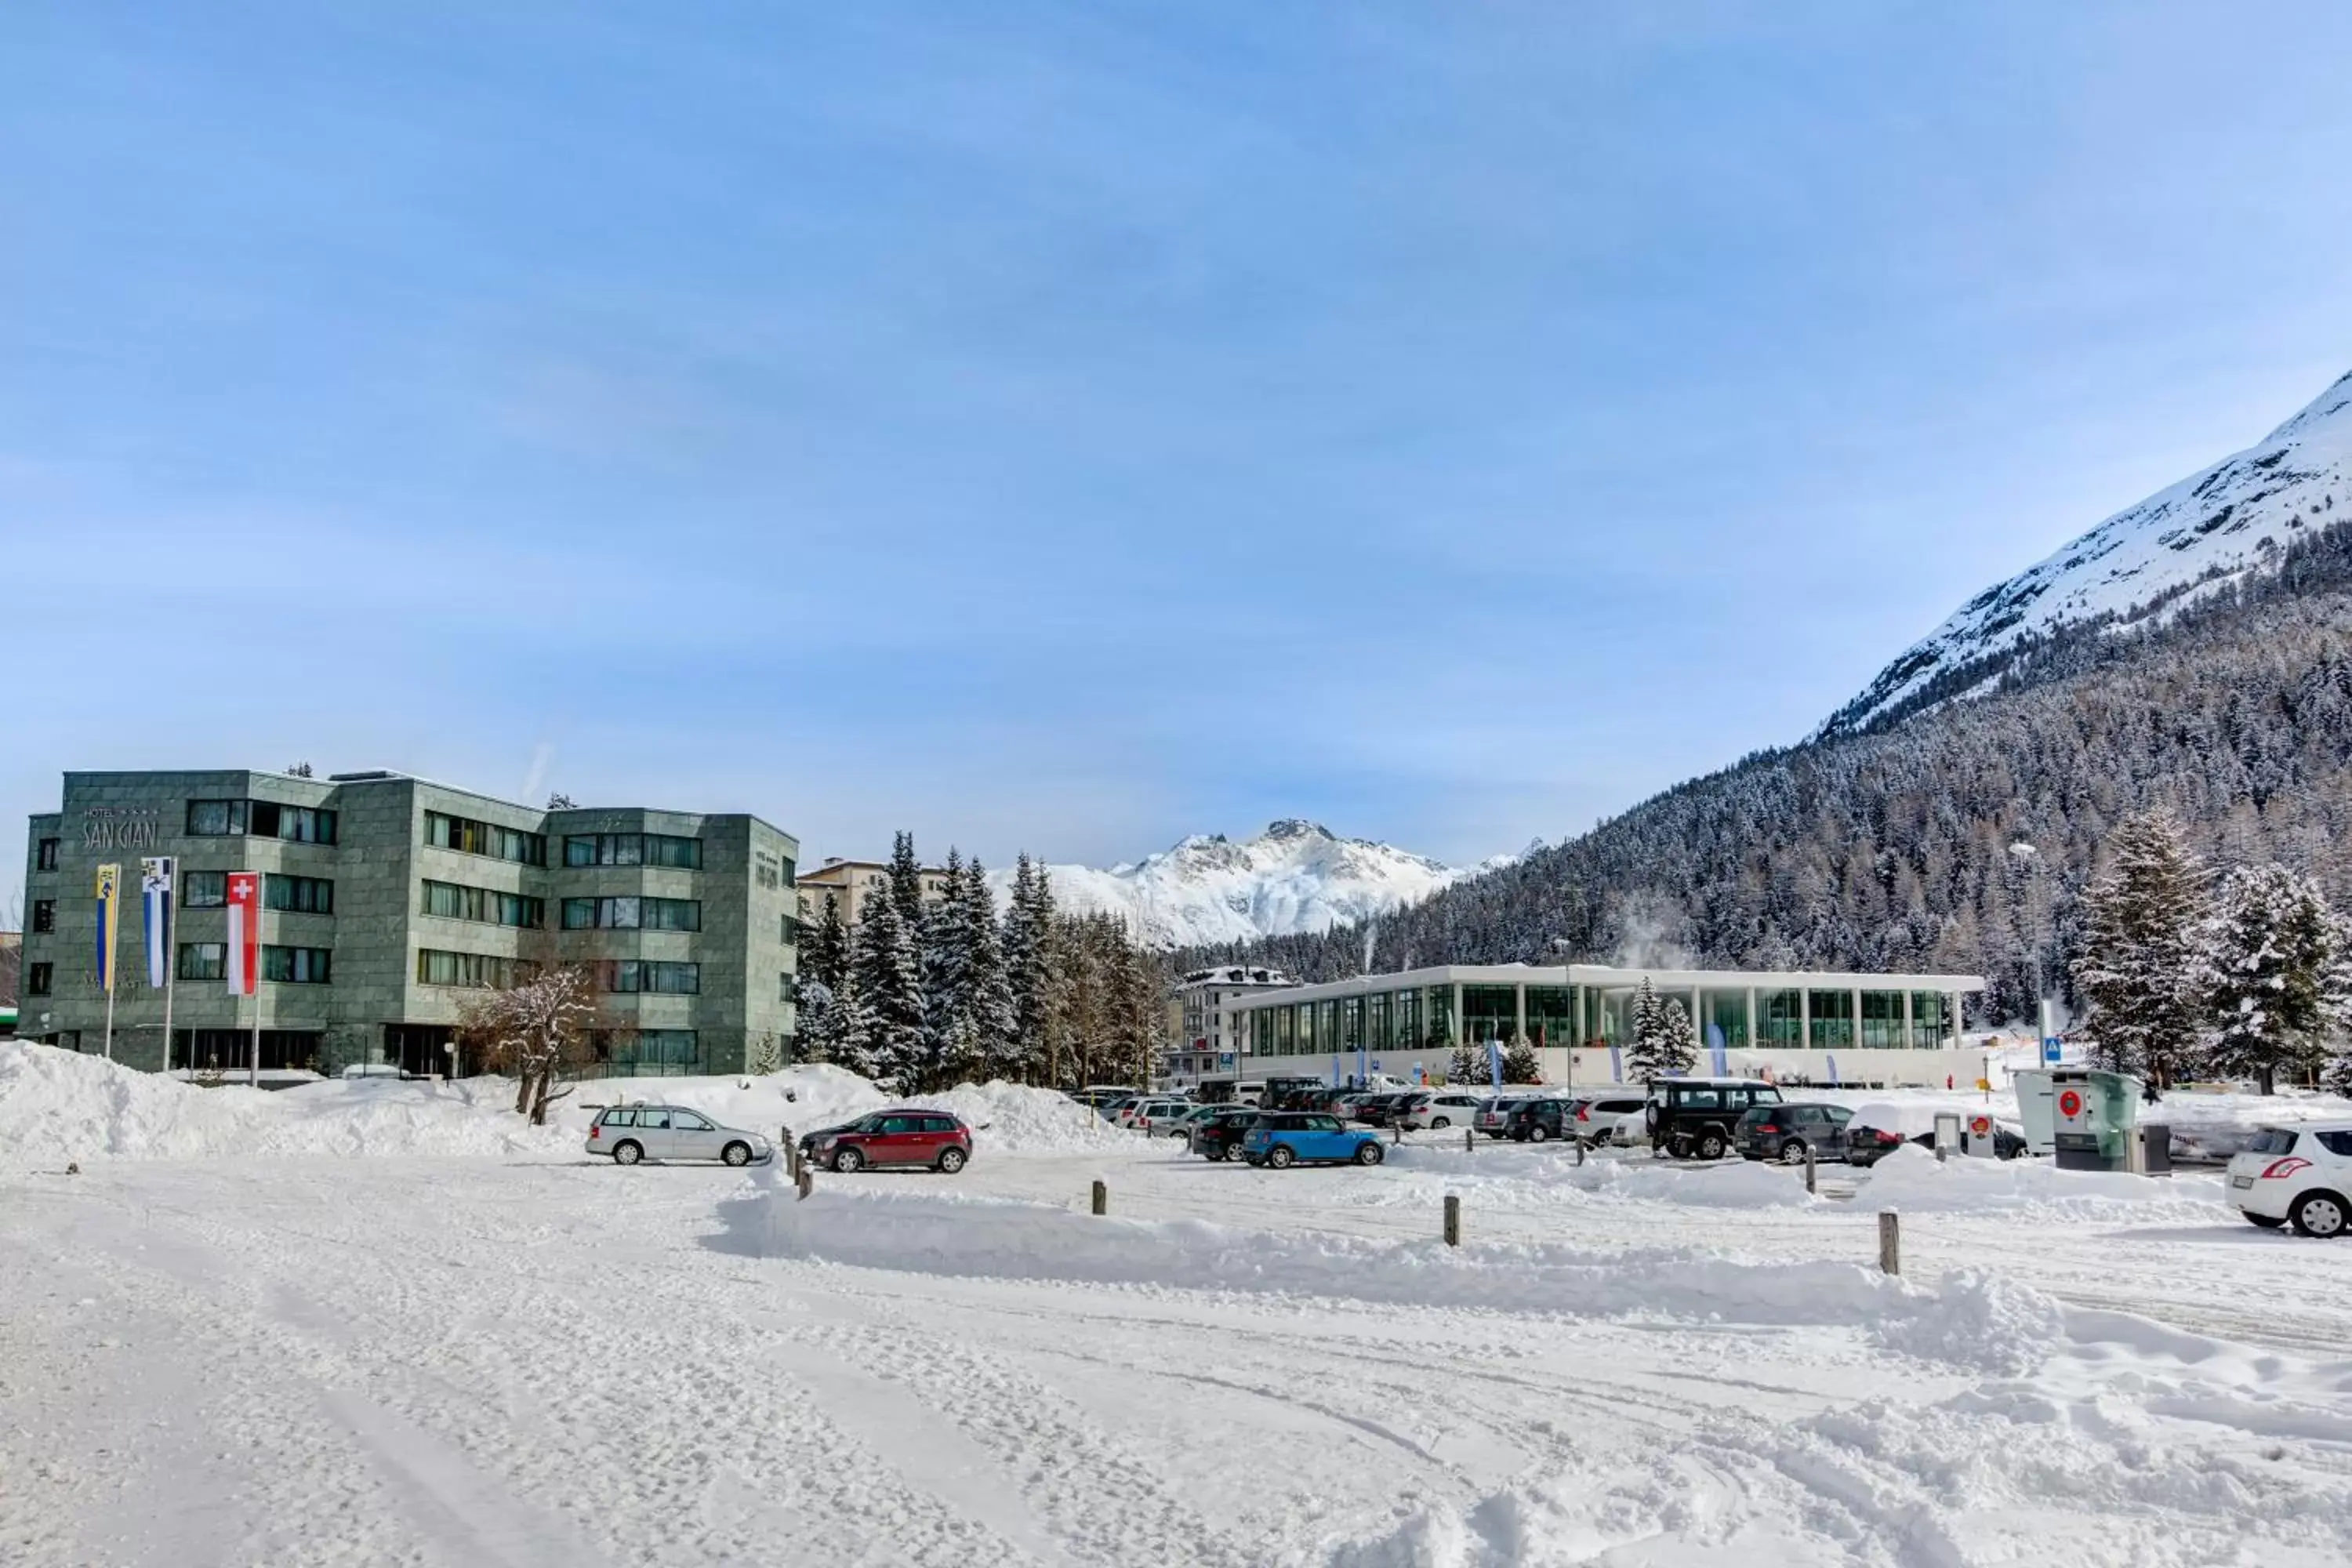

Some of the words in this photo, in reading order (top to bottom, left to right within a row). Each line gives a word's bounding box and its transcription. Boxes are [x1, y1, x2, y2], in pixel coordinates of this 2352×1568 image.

[84, 808, 114, 817] HOTEL
[83, 822, 114, 848] SAN
[118, 822, 156, 848] GIAN
